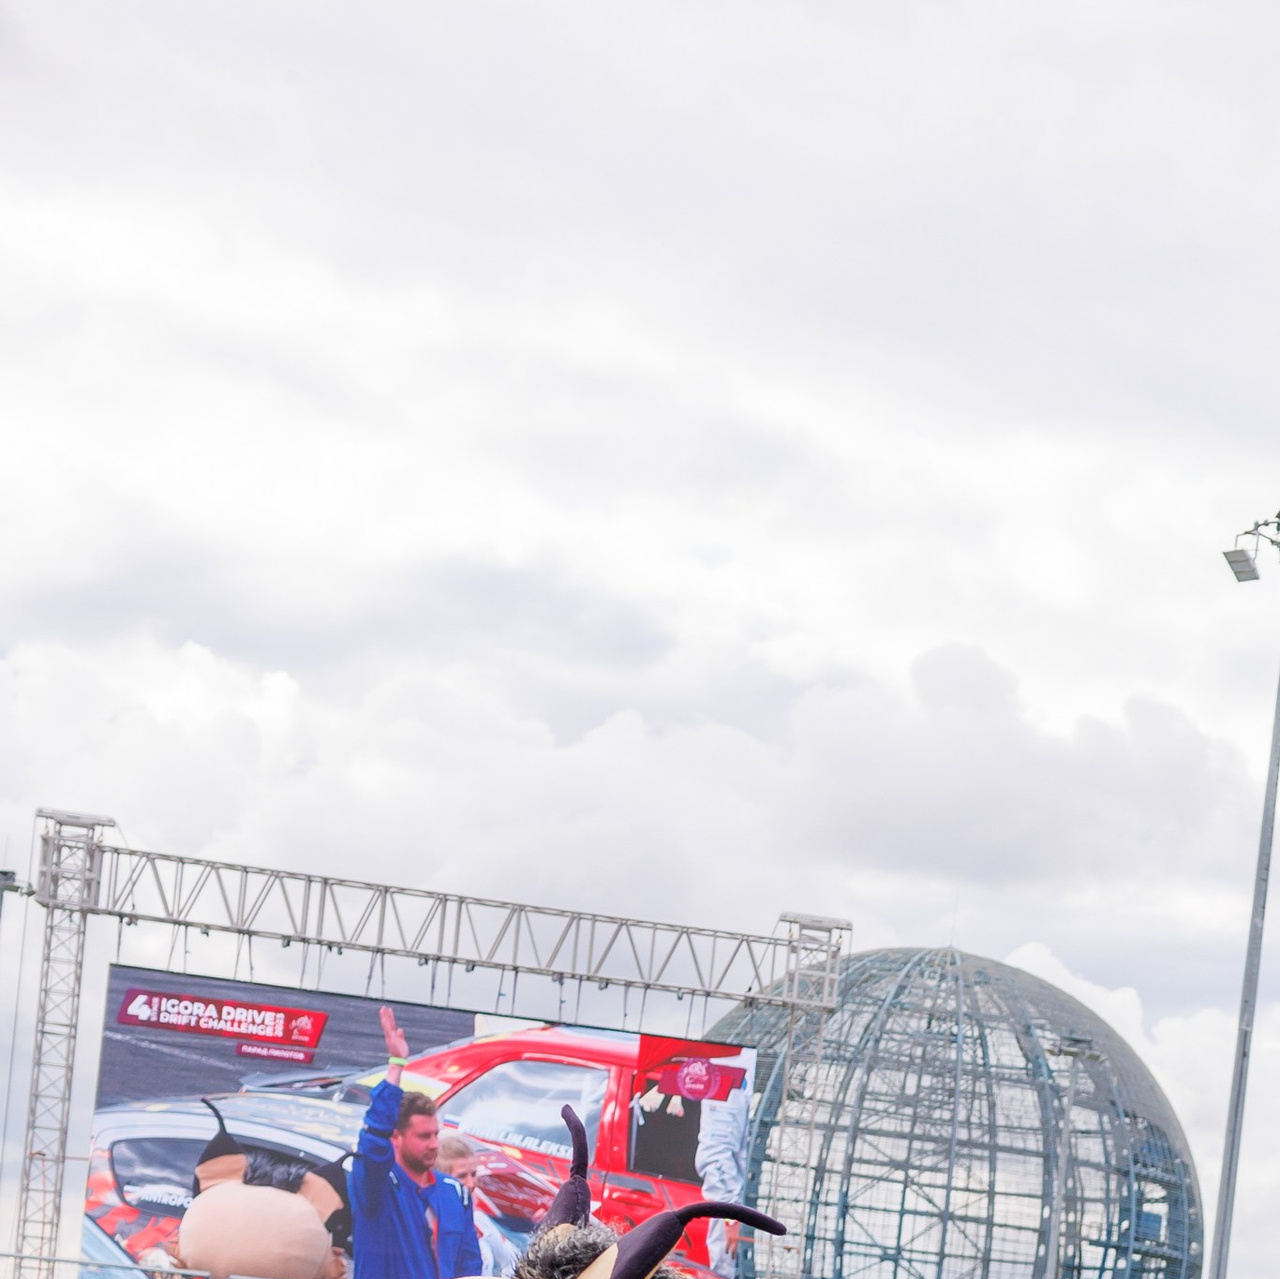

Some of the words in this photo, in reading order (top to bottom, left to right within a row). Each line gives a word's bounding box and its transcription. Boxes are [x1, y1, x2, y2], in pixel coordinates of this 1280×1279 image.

[127, 994, 150, 1021] 4
[161, 998, 220, 1018] IGORA
[221, 1005, 276, 1026] DRIVE
[159, 1013, 197, 1027] DRIFT
[199, 1018, 276, 1037] CHALLENGE
